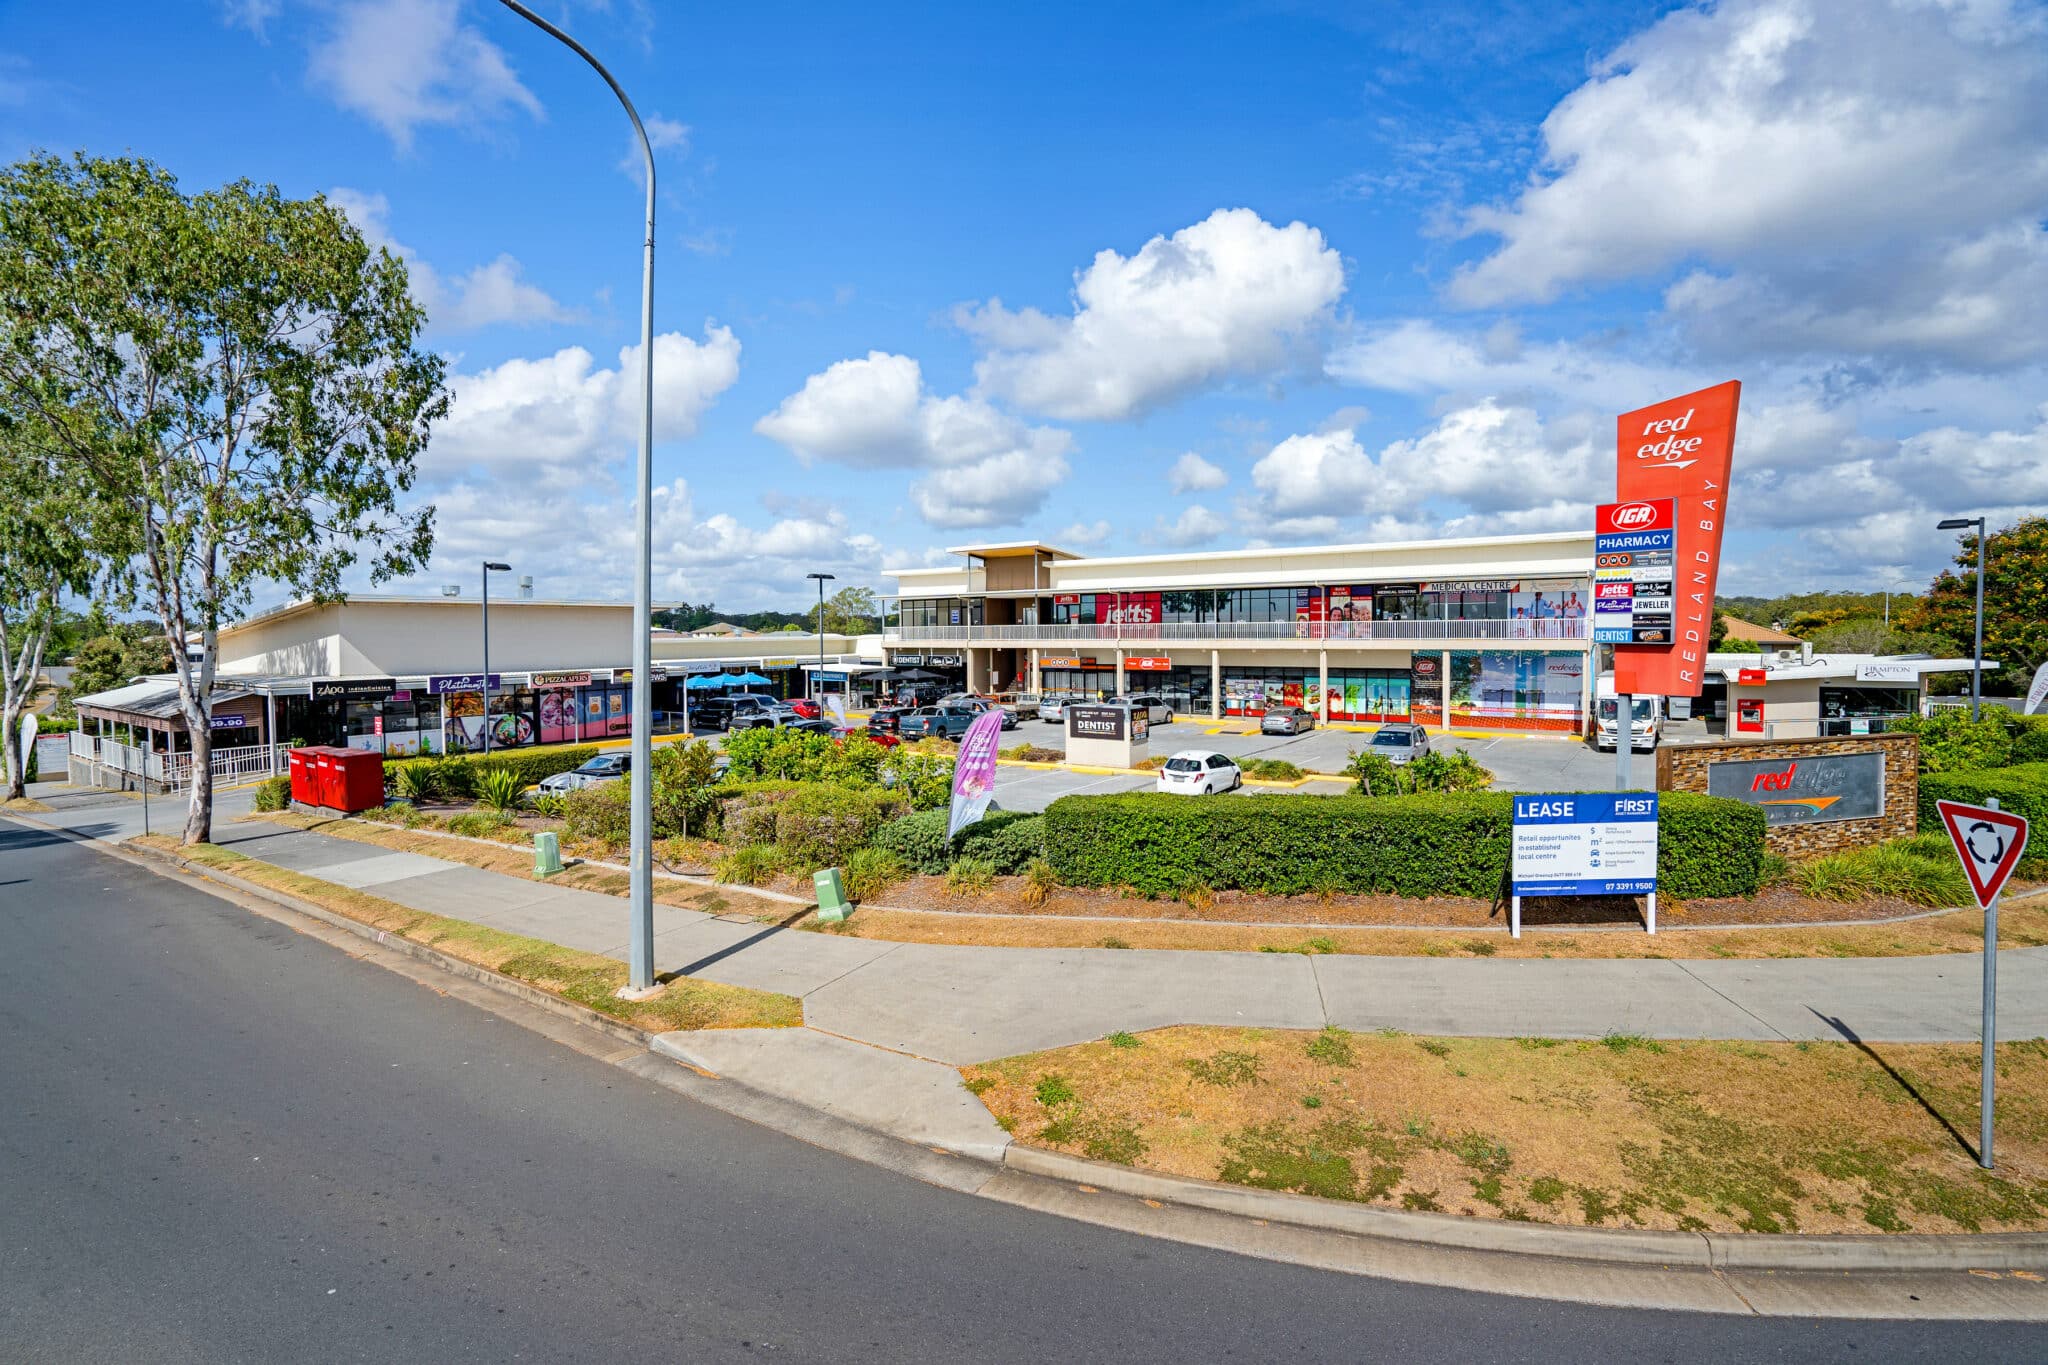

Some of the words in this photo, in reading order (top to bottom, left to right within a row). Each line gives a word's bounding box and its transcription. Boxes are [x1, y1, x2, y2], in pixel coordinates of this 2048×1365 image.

[1643, 408, 1695, 436] red
[1637, 434, 1702, 461] edge
[1616, 507, 1651, 524] IGA
[1599, 534, 1670, 548] PHARMACY
[1431, 582, 1470, 592] MEDICAL
[1474, 581, 1511, 590] CENTRE
[1680, 551, 1709, 682] REDLAND
[1700, 479, 1718, 531] BAY
[1600, 585, 1629, 597] jetts
[1634, 601, 1669, 609] JEWELLER
[1103, 604, 1153, 626] jetts
[1595, 630, 1630, 641] DENTIST
[898, 656, 920, 664] DENTIST
[1865, 666, 1911, 675] HAMPTON
[1078, 720, 1116, 731] DENTIST
[1518, 802, 1574, 818] LEASE
[1615, 799, 1654, 812] FIRST
[1605, 883, 1615, 891] 07
[1616, 882, 1633, 890] 3391
[1635, 882, 1653, 890] 9500
